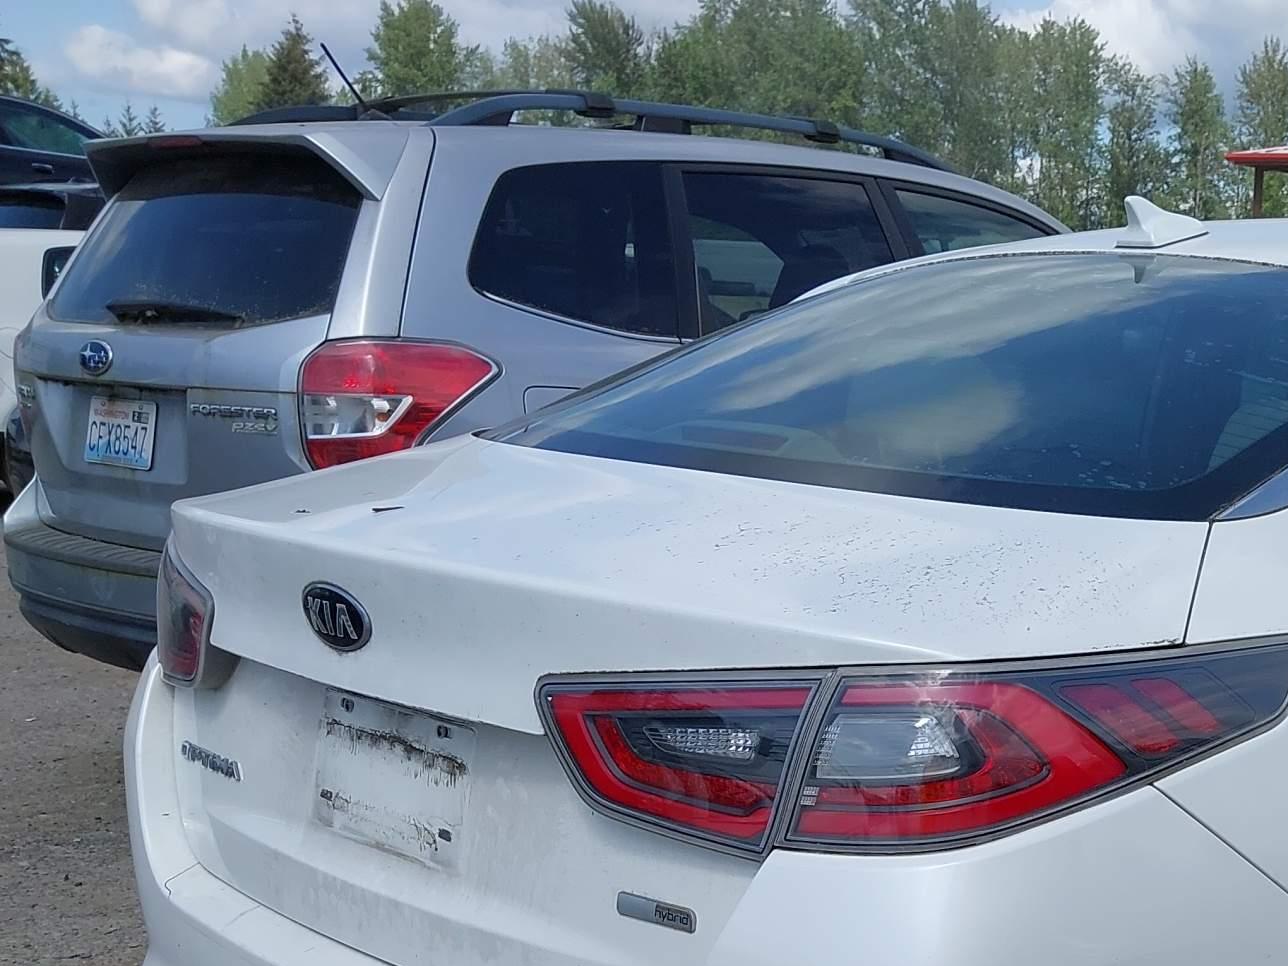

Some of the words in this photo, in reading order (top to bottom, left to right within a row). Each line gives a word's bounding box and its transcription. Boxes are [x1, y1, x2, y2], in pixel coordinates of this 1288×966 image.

[190, 403, 278, 420] FORESTER
[88, 420, 148, 459] CFX8547
[306, 595, 359, 640] KIA
[181, 740, 243, 782] OPTIMA
[654, 903, 689, 926] hybrid
